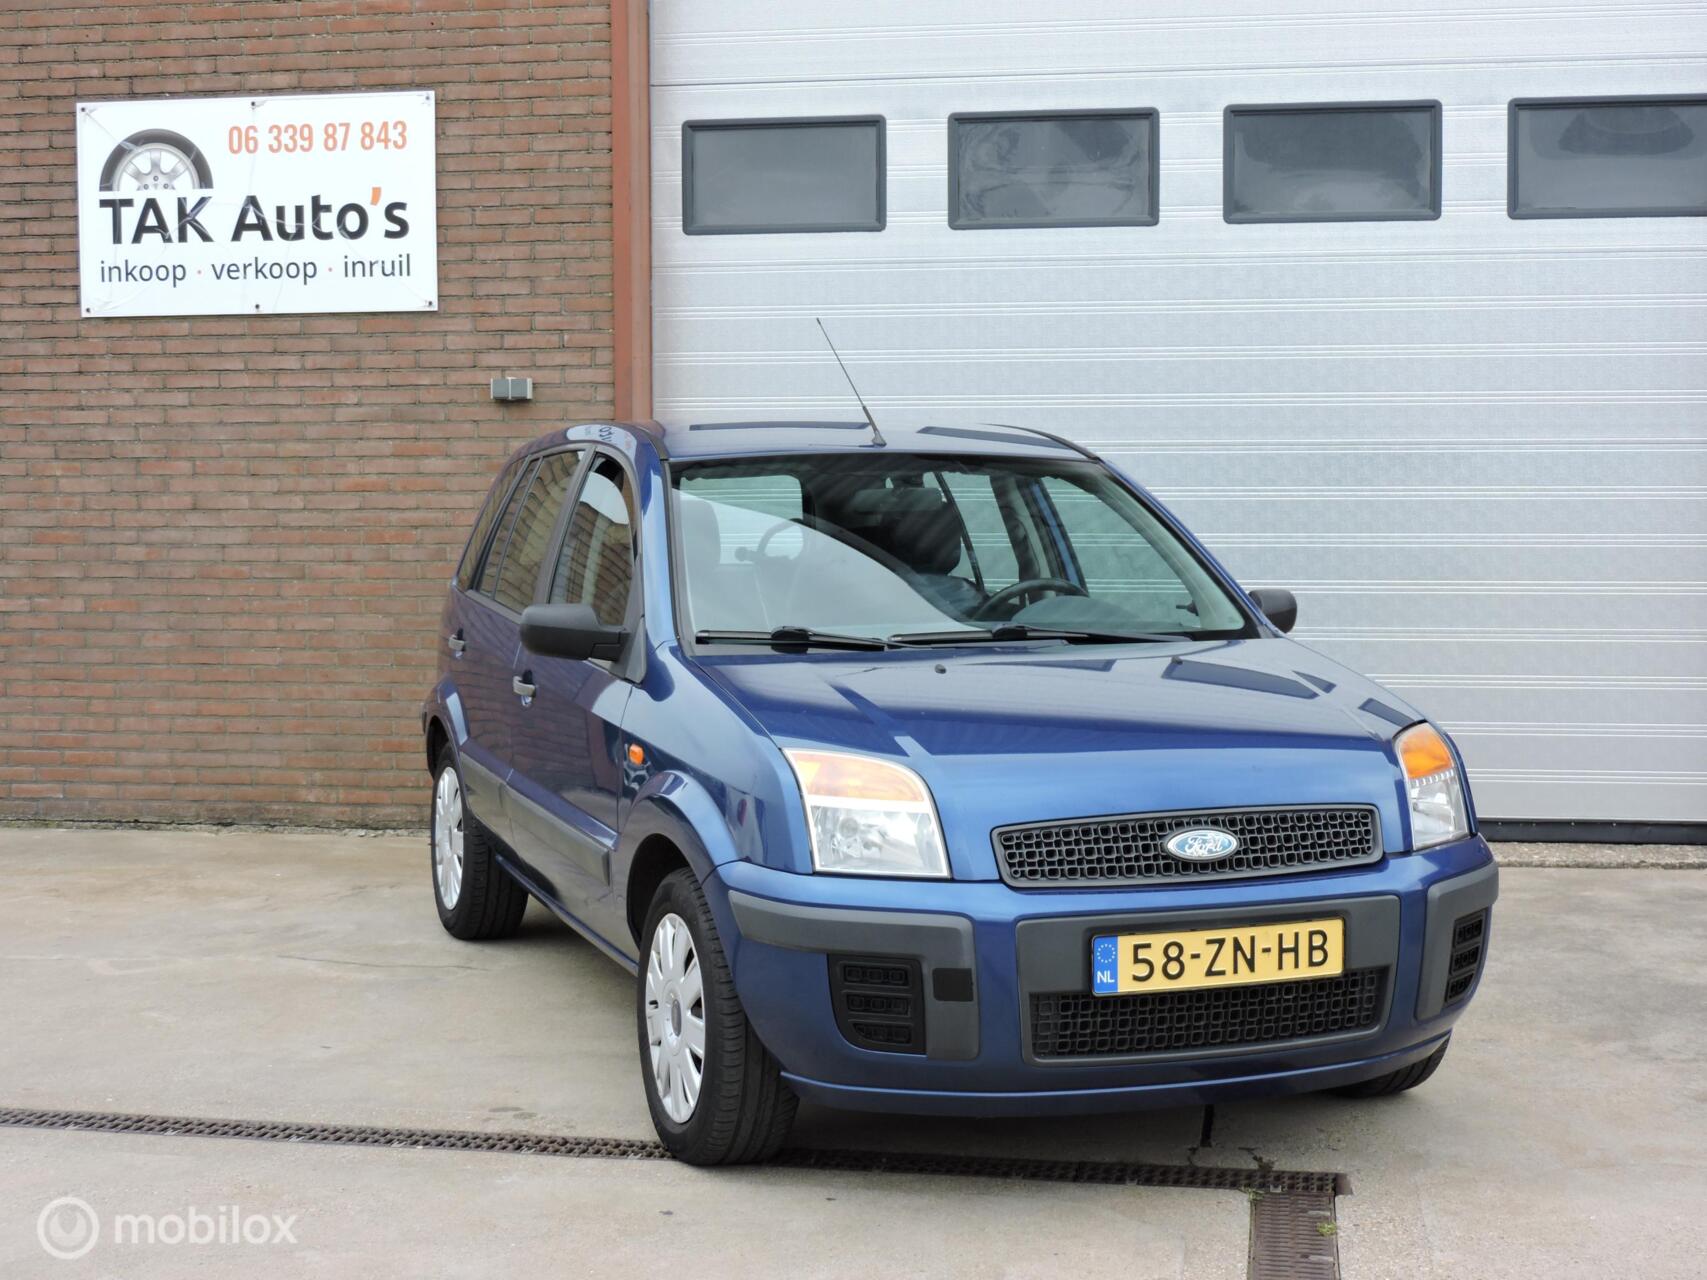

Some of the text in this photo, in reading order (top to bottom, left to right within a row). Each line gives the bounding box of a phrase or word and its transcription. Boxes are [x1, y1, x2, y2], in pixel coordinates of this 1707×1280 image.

[229, 120, 407, 154] 06 339 87 843
[99, 187, 410, 245] TAK Auto's
[100, 254, 411, 288] inkoop verkoop inruil
[1184, 833, 1223, 854] Ford
[1131, 929, 1329, 983] 58-ZN-HB
[1096, 970, 1116, 984] NL
